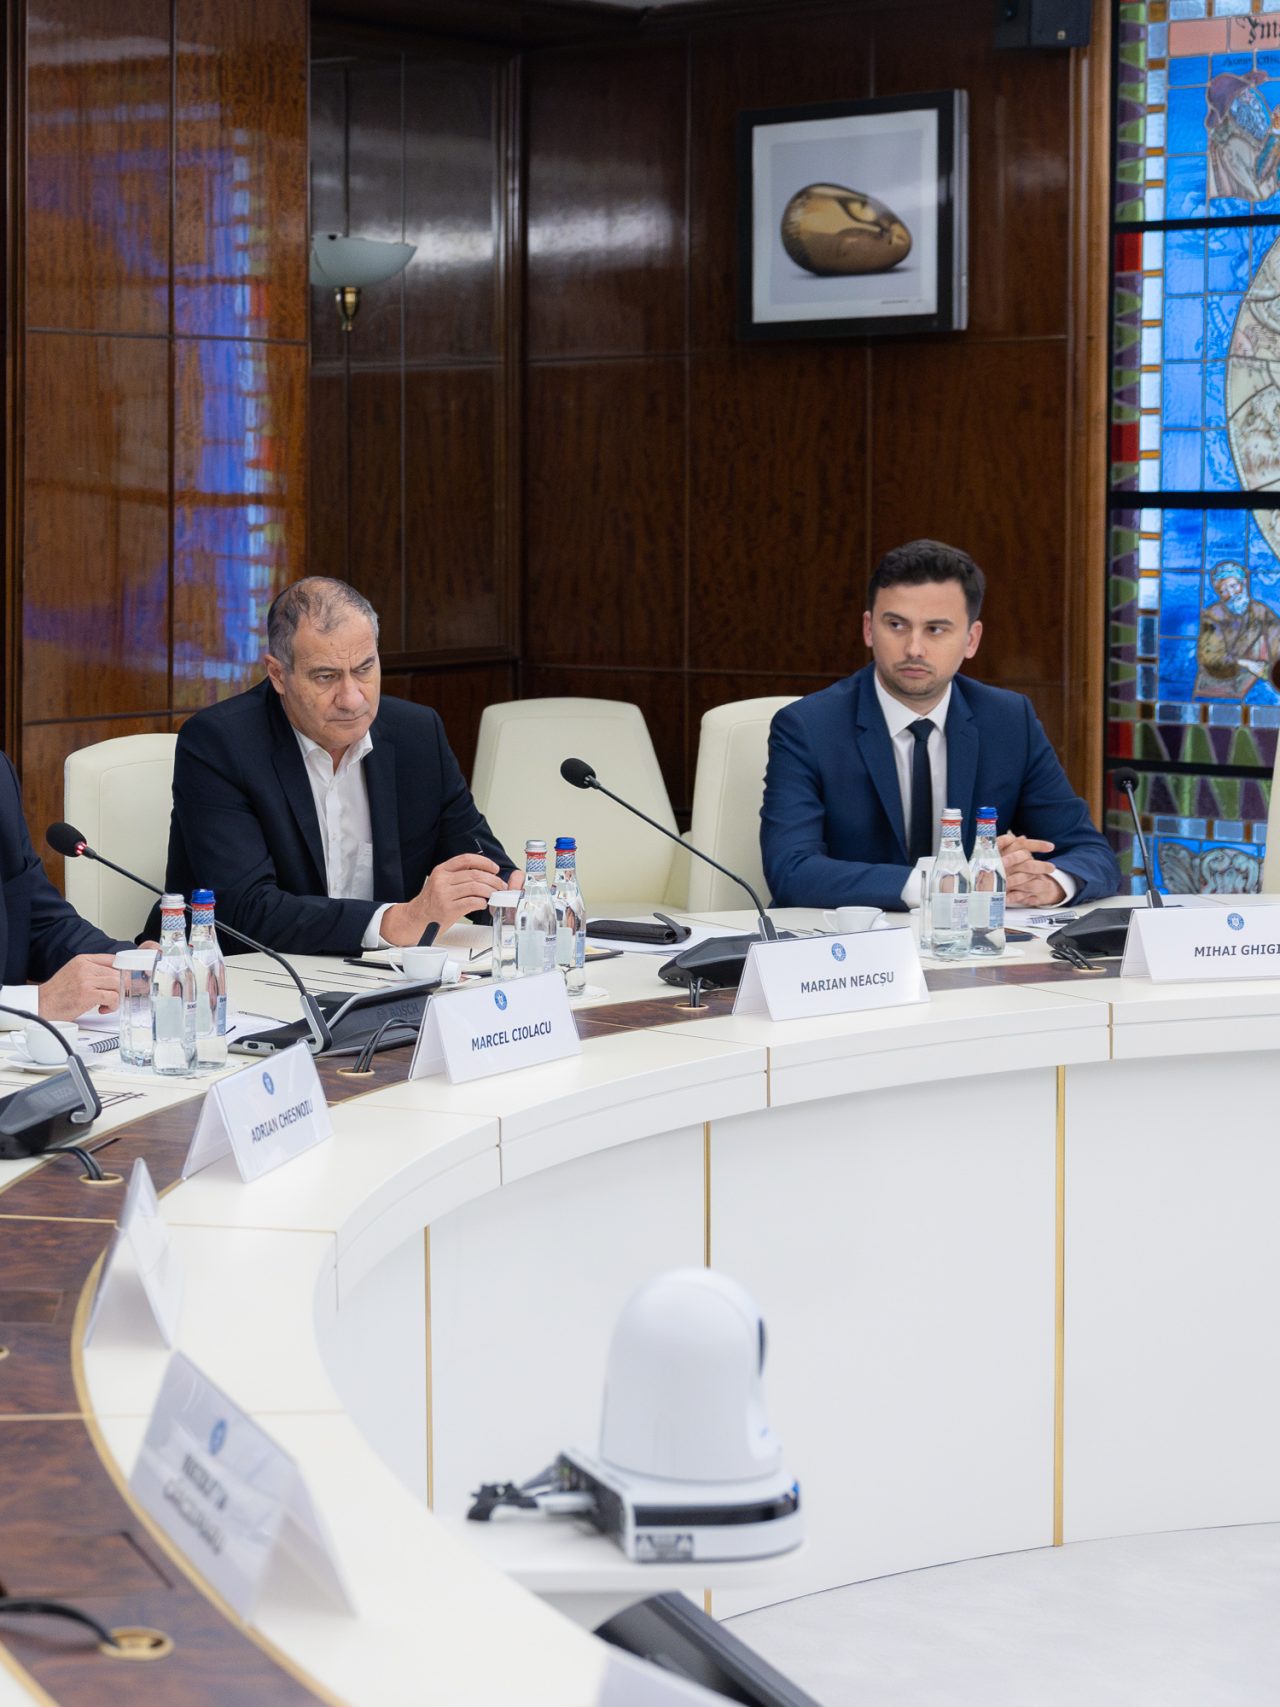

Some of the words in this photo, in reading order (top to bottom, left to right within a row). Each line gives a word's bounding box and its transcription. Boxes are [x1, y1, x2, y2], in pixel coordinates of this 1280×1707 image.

[1194, 945, 1237, 957] MIHAI
[800, 977, 847, 994] MARIAN
[471, 1030, 510, 1051] MARCEL
[511, 1020, 552, 1042] CIOLACU
[251, 1116, 279, 1144] ADRIAN
[278, 1098, 314, 1129] CHESNOIU
